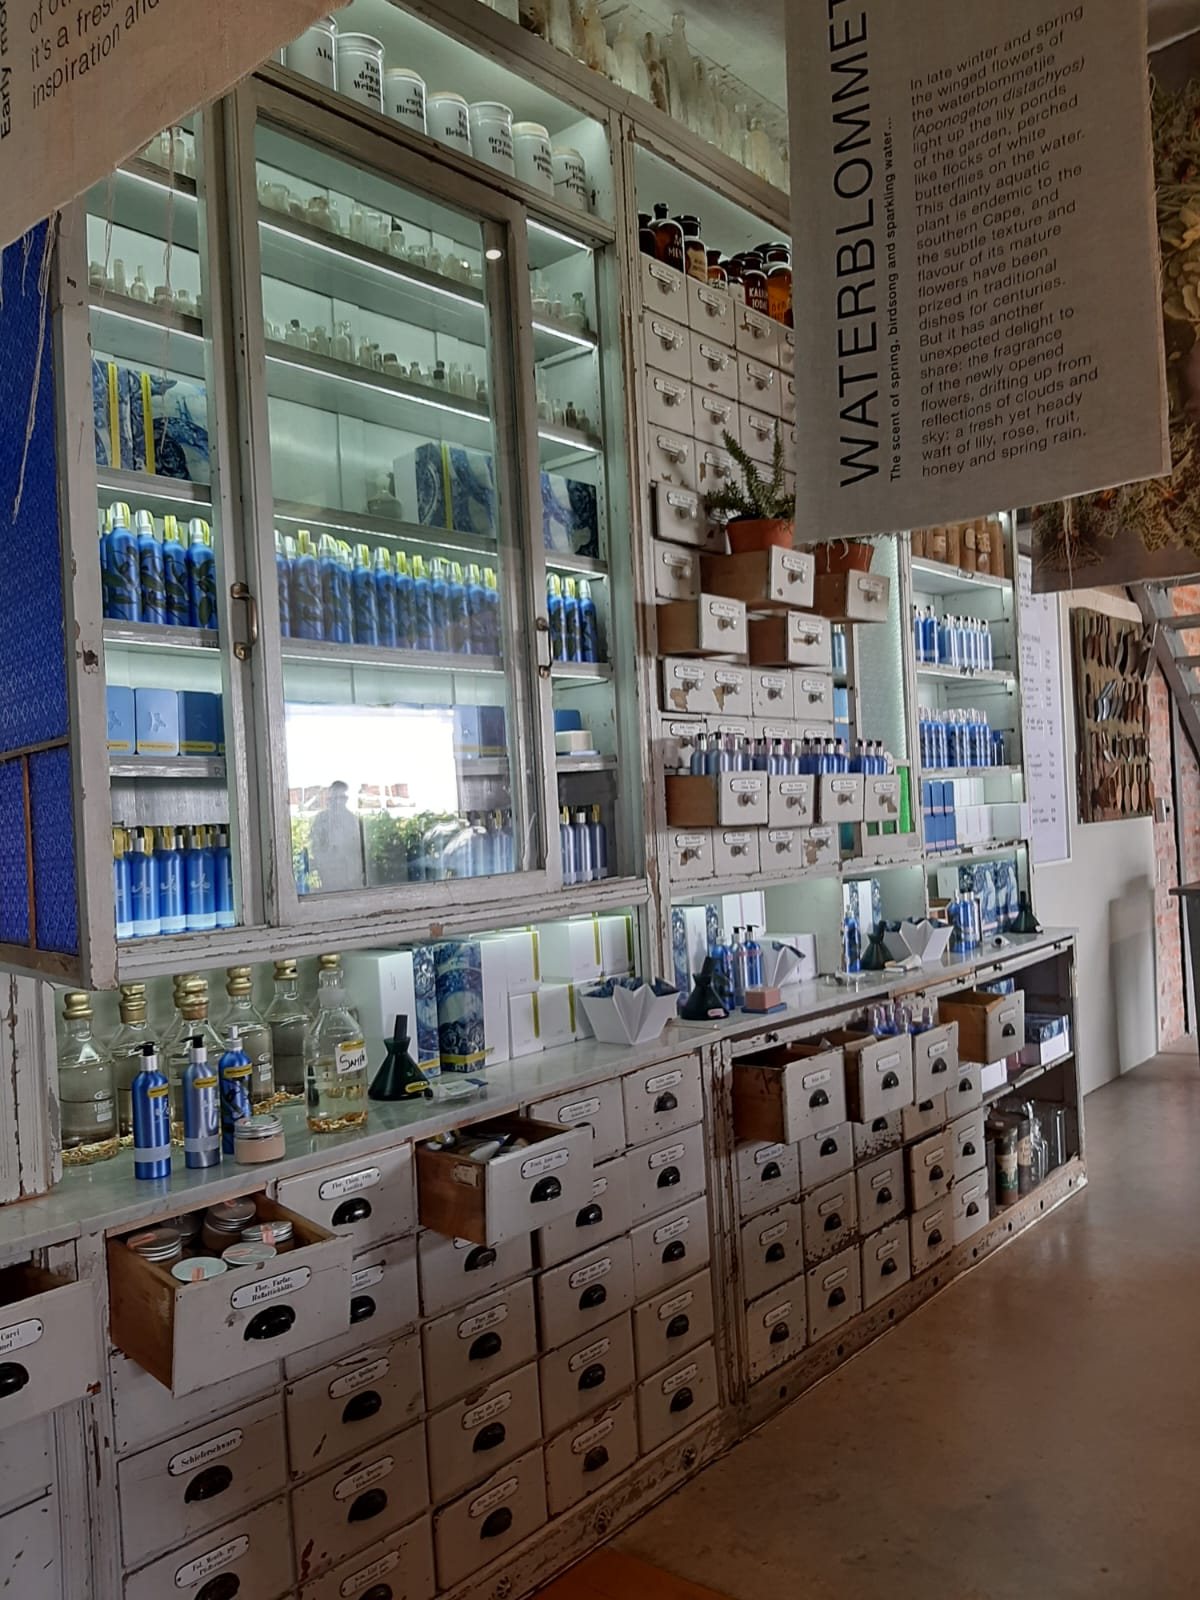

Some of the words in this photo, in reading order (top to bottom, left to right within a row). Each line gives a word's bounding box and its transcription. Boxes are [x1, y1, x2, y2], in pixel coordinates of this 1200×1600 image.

[29, 1, 43, 33] of
[31, 37, 52, 72] it's
[56, 26, 69, 48] a
[77, 0, 117, 37] fres
[32, 23, 120, 109] inspiration
[911, 80, 922, 90] In
[928, 69, 952, 84] late
[957, 46, 998, 72] winter
[1004, 29, 1030, 51] and
[1037, 6, 1083, 36] spring
[912, 92, 932, 106] the
[938, 65, 986, 96] winged
[992, 43, 1043, 72] flowers
[1050, 30, 1063, 46] of
[912, 108, 933, 122] the
[914, 136, 941, 153] light
[948, 129, 964, 142] up
[970, 117, 991, 133] the
[997, 108, 1014, 120] lily
[1021, 85, 1066, 115] ponds
[914, 156, 926, 169] of
[932, 150, 953, 163] the
[1018, 94, 1077, 133] perched
[881, 116, 893, 170] water...
[914, 171, 936, 185] like
[943, 153, 982, 176] flocks
[988, 142, 1001, 158] of
[1007, 129, 1045, 150] white
[916, 170, 983, 201] butterflies
[989, 161, 1006, 174] on
[1013, 150, 1034, 166] the
[916, 202, 943, 216] This
[950, 184, 990, 207] dainty
[996, 161, 1049, 188] aquatic
[917, 214, 949, 236] plant
[956, 211, 966, 221] is
[972, 186, 1032, 214] endemic
[1038, 177, 1052, 190] to
[1059, 166, 1081, 182] the
[883, 173, 898, 239] sparkling
[917, 222, 977, 249] southern
[1032, 188, 1058, 210] and
[918, 253, 938, 266] the
[944, 236, 986, 257] subtle
[992, 216, 1042, 240] texture
[1048, 200, 1075, 220] and
[885, 242, 897, 269] and
[918, 261, 964, 282] flavour
[970, 251, 982, 266] of
[988, 246, 1004, 259] its
[1010, 226, 1061, 251] mature
[919, 277, 968, 298] flowers
[974, 262, 1006, 281] have
[1012, 248, 1047, 268] been
[886, 271, 900, 336] birdsong
[919, 293, 961, 317] prized
[968, 289, 978, 301] in
[984, 258, 1056, 294] traditional
[919, 312, 964, 330] dishes
[970, 302, 987, 317] for
[920, 332, 942, 347] But
[948, 328, 955, 340] it
[962, 320, 984, 336] has
[990, 301, 1043, 325] another
[920, 329, 999, 362] unexpected
[1005, 313, 1052, 337] delight
[1060, 308, 1074, 320] to
[887, 338, 901, 389] spring,
[921, 382, 933, 395] of
[939, 379, 960, 392] the
[966, 364, 1003, 385] newly
[1009, 343, 1063, 371] opened
[968, 353, 988, 367] the
[994, 330, 1062, 358] fragrance
[889, 393, 900, 408] of
[922, 402, 991, 428] reflections
[997, 394, 1010, 408] of
[1016, 381, 1064, 403] clouds
[1070, 367, 1098, 386] and
[980, 376, 1028, 397] drifting
[1034, 368, 1052, 381] up
[1058, 355, 1091, 372] from
[889, 411, 901, 450] scent
[956, 428, 963, 438] a
[970, 414, 1002, 433] fresh
[1009, 407, 1030, 425] yet
[1037, 392, 1082, 415] heady
[890, 455, 901, 482] The
[922, 445, 950, 460] waft
[957, 440, 970, 454] of
[923, 460, 964, 477] honey
[970, 449, 995, 467] and
[1002, 438, 1047, 459] spring
